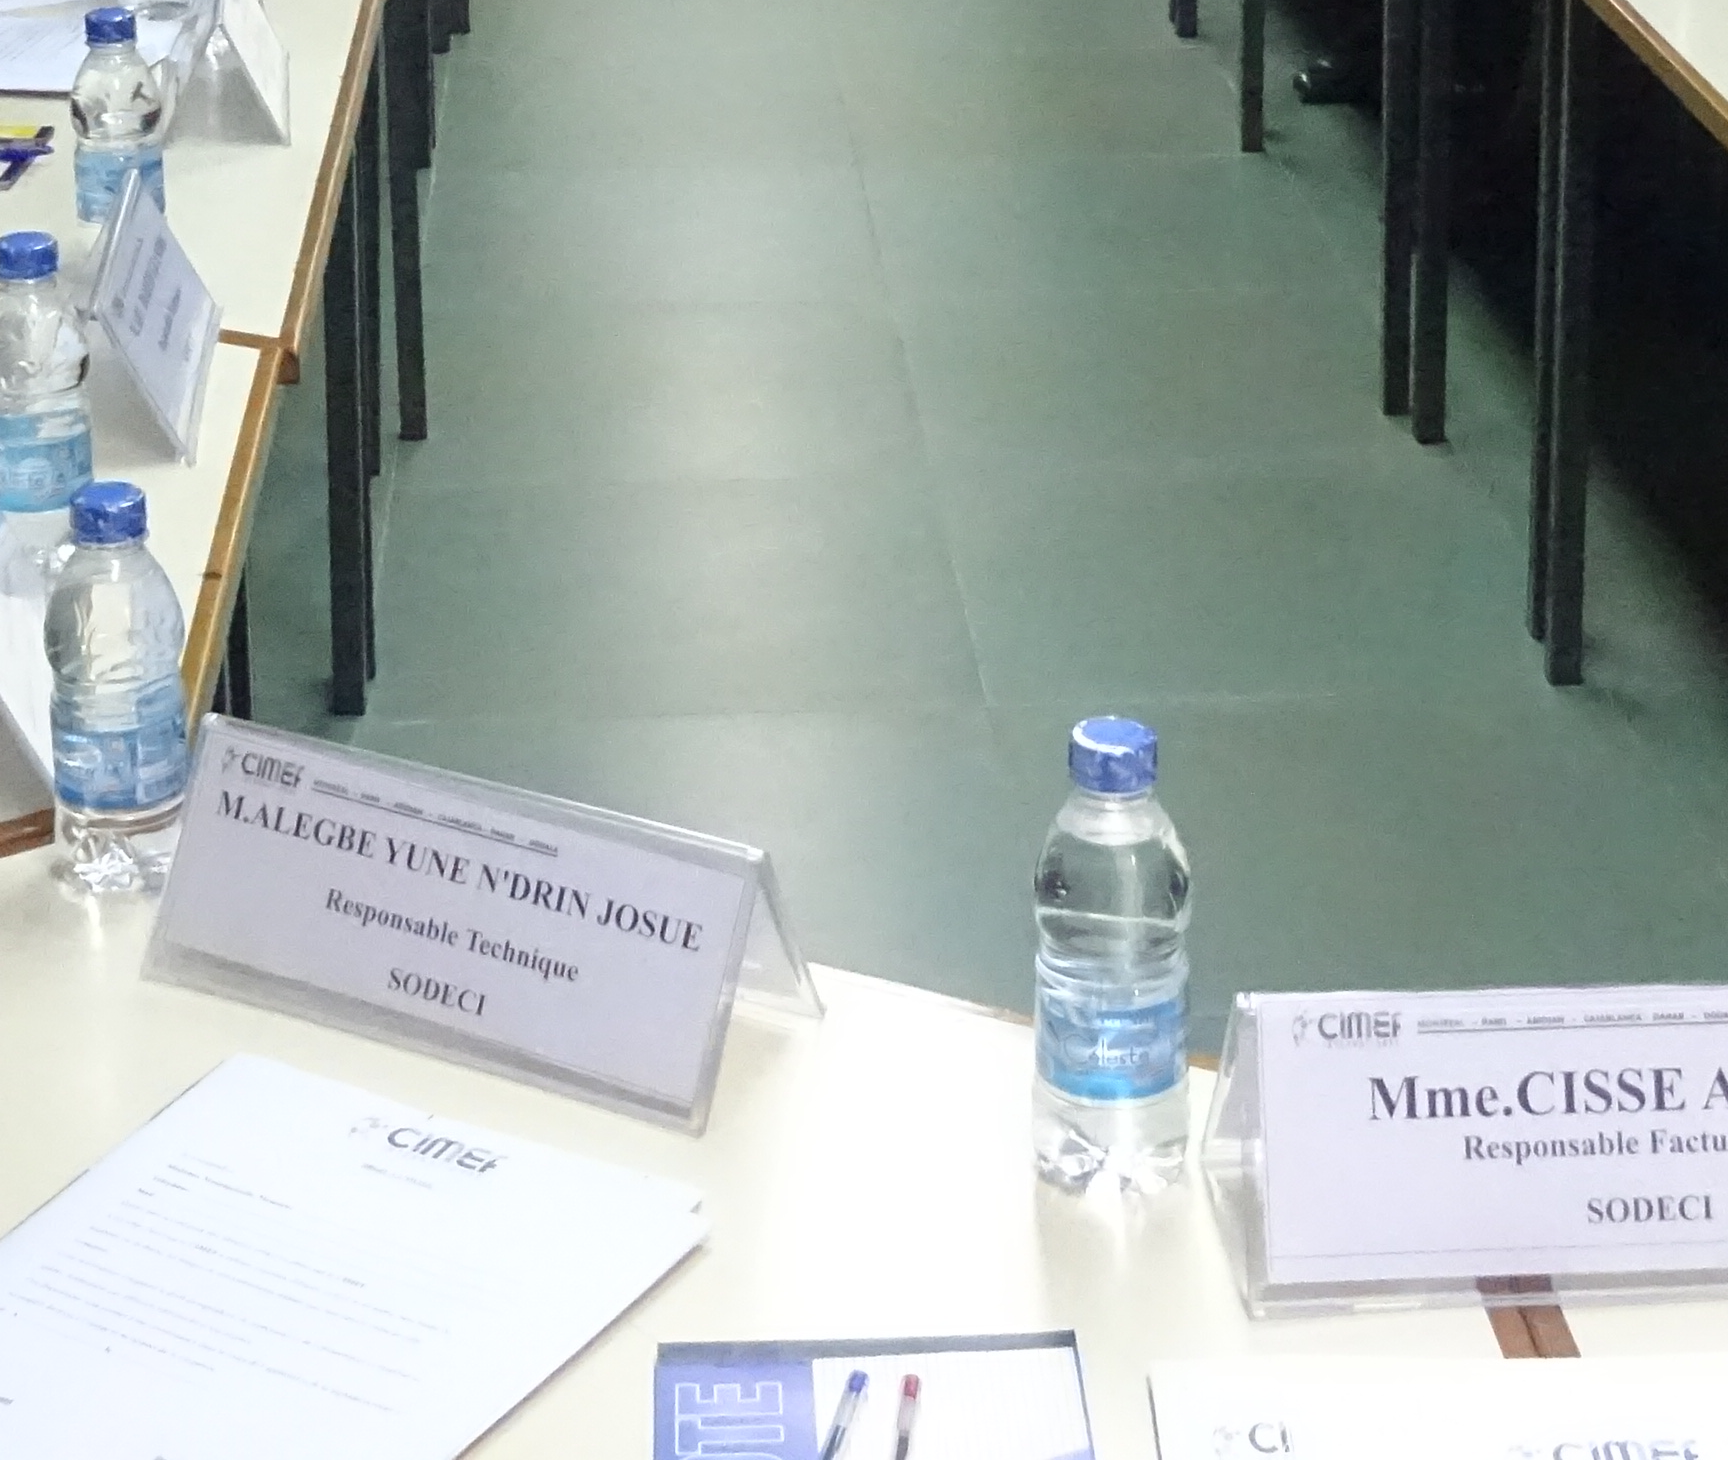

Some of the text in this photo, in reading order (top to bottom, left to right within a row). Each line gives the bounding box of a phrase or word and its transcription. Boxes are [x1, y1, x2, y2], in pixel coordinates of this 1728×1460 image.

[241, 750, 305, 789] CIMEF
[217, 790, 703, 952] M.ALEGBE YUNE N'DRIN JOSUE
[325, 887, 579, 983] Responsable Technique
[387, 966, 487, 1017] SODECI
[1317, 1011, 1401, 1040] CIMEF
[1368, 1066, 1687, 1121] Mme.CISSE
[387, 1127, 508, 1173] CIMEF
[1463, 1131, 1640, 1164] Responsable
[1586, 1195, 1714, 1224] SODECI
